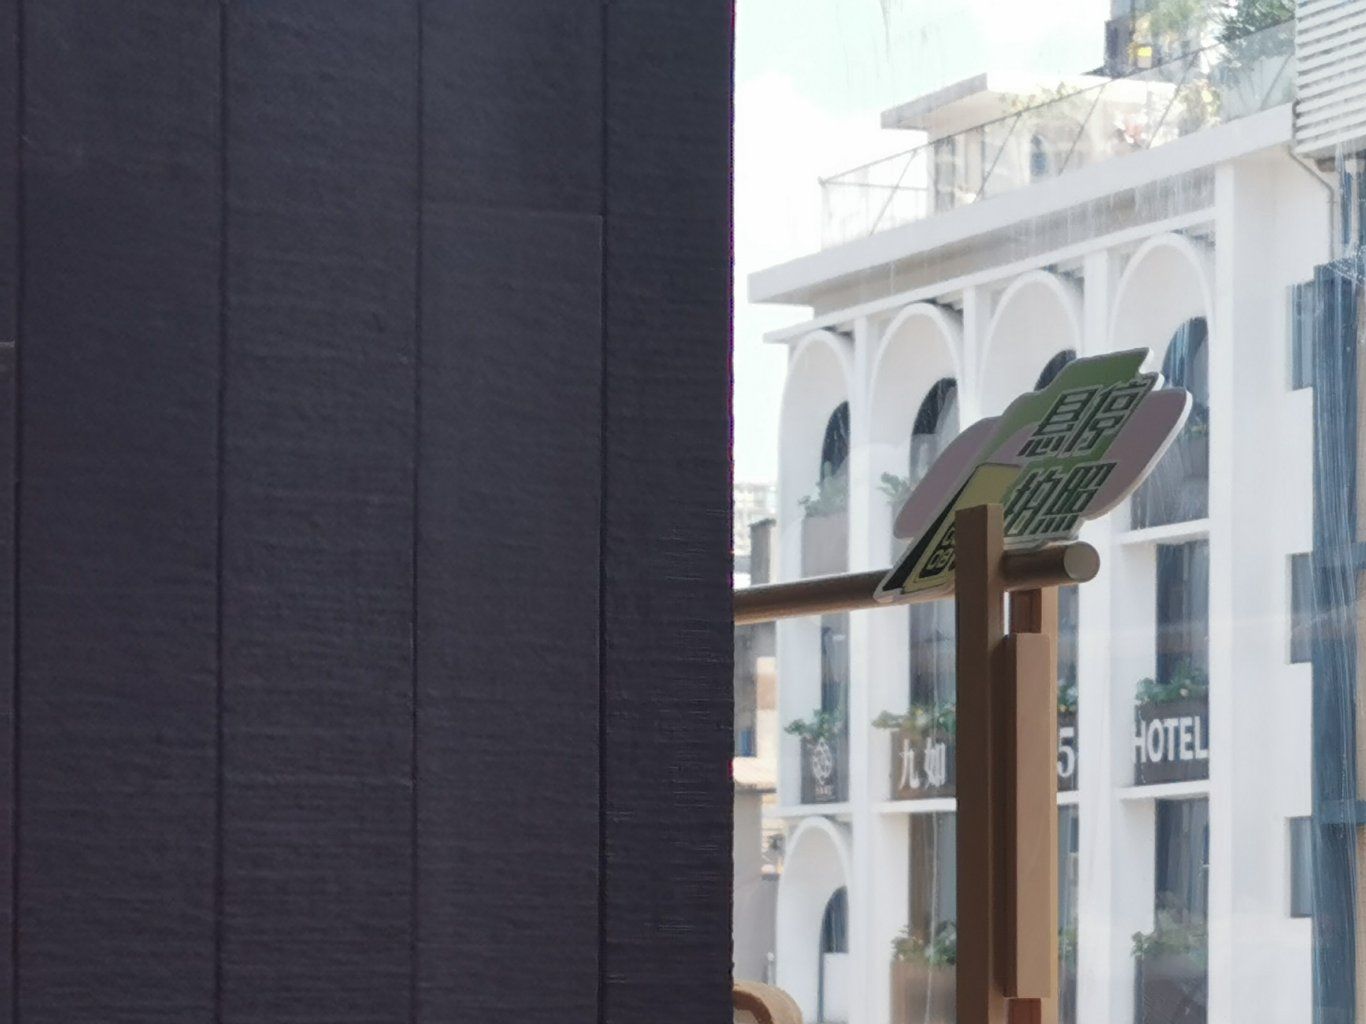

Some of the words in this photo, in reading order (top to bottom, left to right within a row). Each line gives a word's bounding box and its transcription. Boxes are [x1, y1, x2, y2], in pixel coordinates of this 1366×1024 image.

[1002, 462, 1118, 538] 拍照
[899, 737, 946, 790] 九如
[1133, 715, 1208, 764] HOTEL
